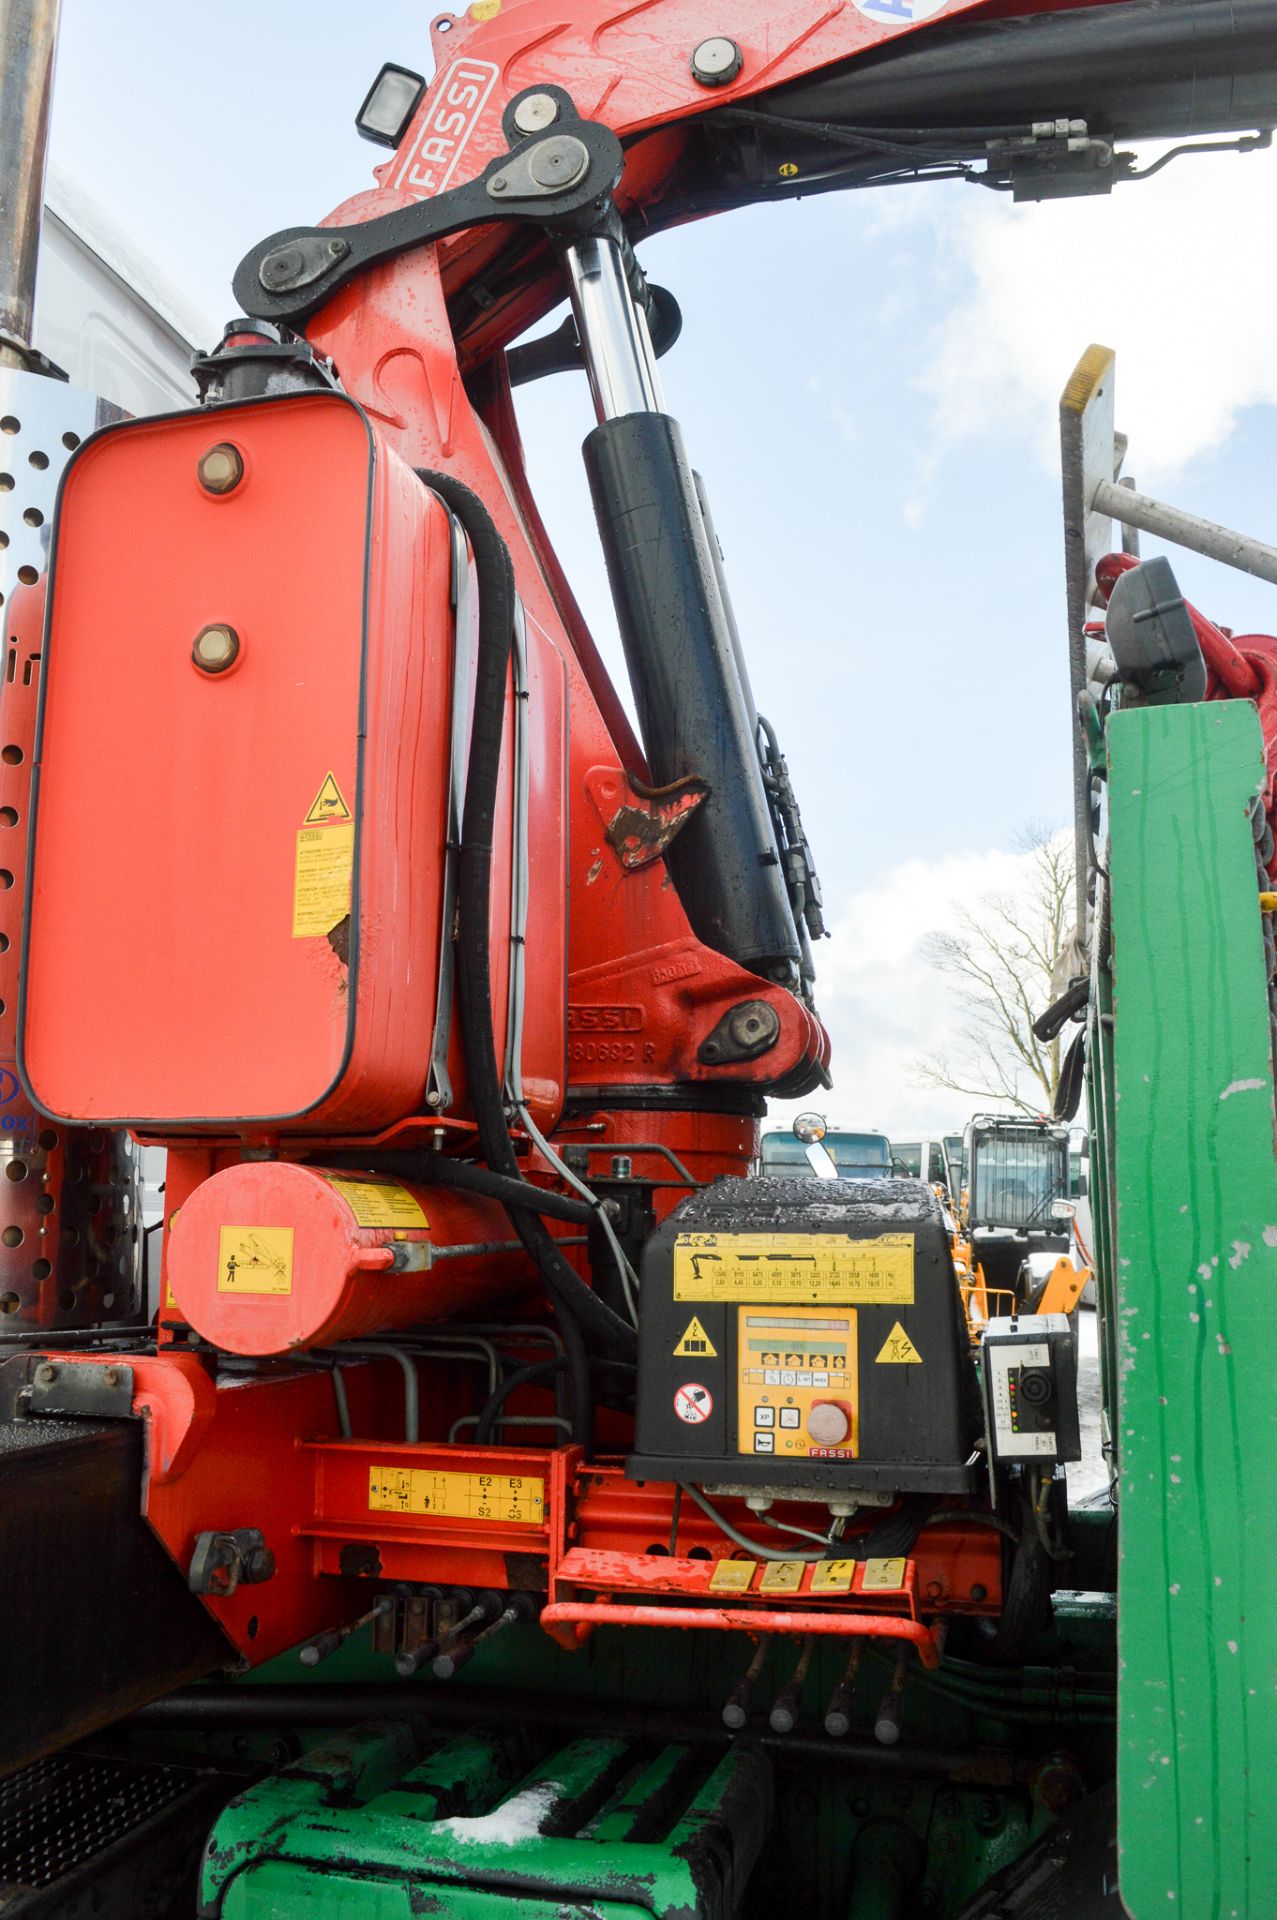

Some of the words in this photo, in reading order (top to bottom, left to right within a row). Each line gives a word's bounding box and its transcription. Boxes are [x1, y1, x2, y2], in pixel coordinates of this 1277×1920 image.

[408, 71, 487, 189] FASSI
[811, 1448, 851, 1458] FASSI
[479, 1477, 492, 1487] E2
[509, 1479, 522, 1489] E3
[478, 1507, 491, 1517] S2
